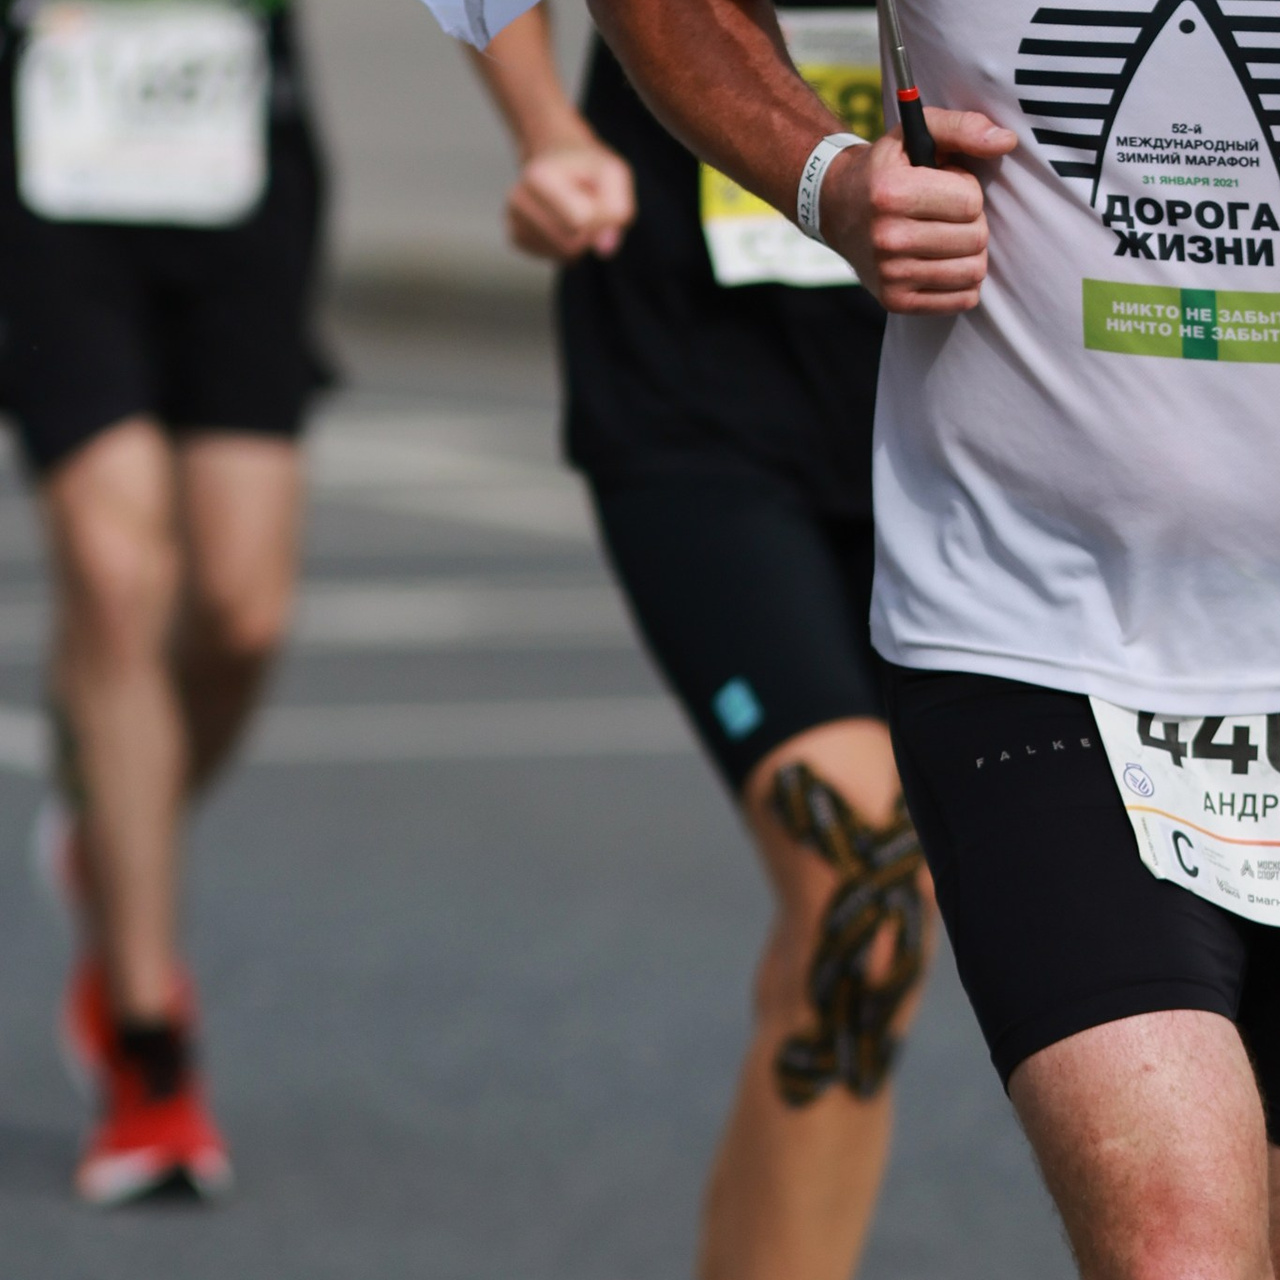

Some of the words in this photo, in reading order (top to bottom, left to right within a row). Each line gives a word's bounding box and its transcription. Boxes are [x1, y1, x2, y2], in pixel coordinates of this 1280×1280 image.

[1171, 123, 1203, 135] 52-й
[1115, 136, 1260, 153] МЕЖДУНАРОДНЫЙ
[1116, 152, 1182, 166] ЗИМНИЙ
[1184, 154, 1260, 168] МАРАФОН
[1142, 175, 1155, 185] 31
[1159, 176, 1210, 187] ЯНВАРЯ
[1213, 178, 1239, 188] 2021
[1112, 228, 1276, 267] ЖИЗНИ
[1111, 300, 1180, 320] НИКТО
[1185, 307, 1213, 323] НЕ
[1106, 317, 1173, 337] НИЧТО
[1178, 324, 1205, 340] НЕ
[975, 738, 1092, 769] FALKE
